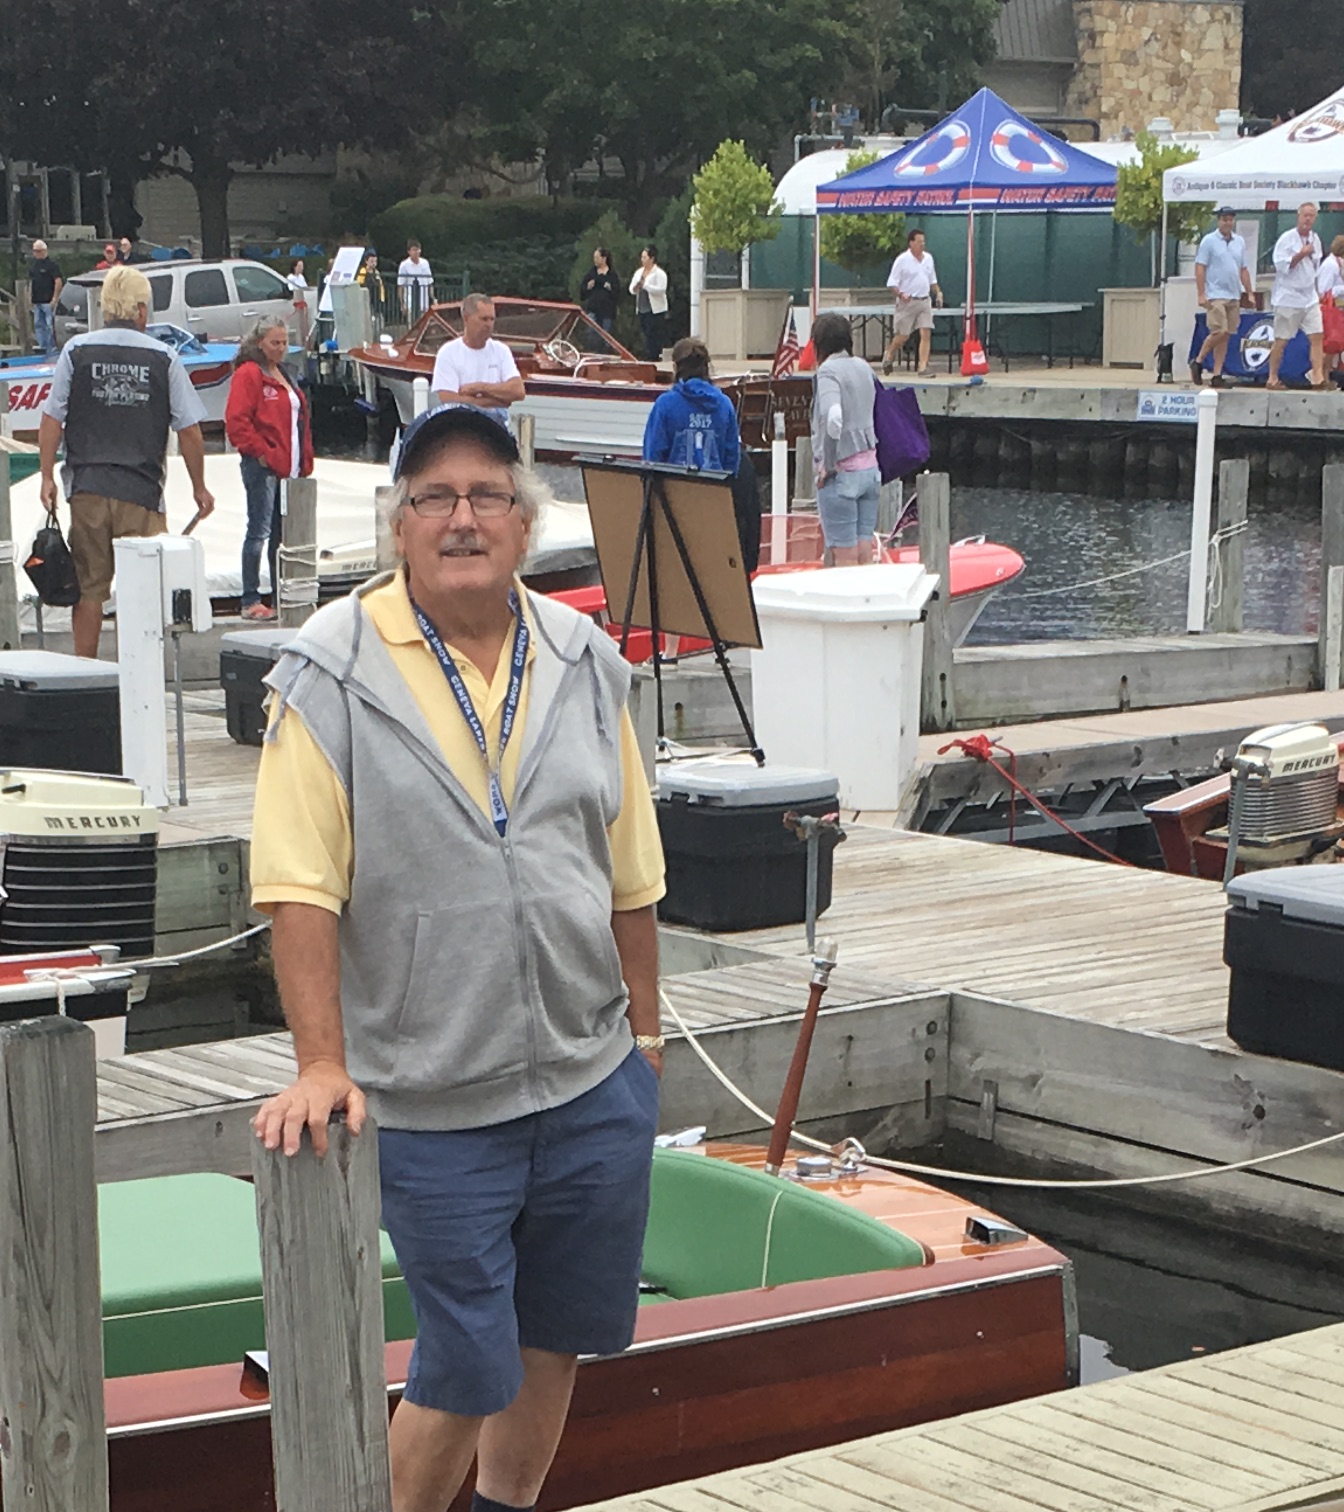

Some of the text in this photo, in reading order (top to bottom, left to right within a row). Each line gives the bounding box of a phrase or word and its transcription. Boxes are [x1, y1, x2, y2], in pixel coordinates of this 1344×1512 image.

[1216, 180, 1237, 189] Classic
[1239, 180, 1252, 189] Boat
[1254, 180, 1276, 191] Society
[1277, 180, 1311, 189] Blackhawk
[1313, 180, 1337, 191] Chapter
[91, 363, 150, 383] CHROME
[7, 383, 54, 411] SAF
[1162, 395, 1167, 404] 2
[1158, 406, 1197, 416] PARKING
[689, 419, 713, 429] 2017
[431, 635, 452, 666] SHOW
[450, 674, 471, 716] GENEVA
[508, 676, 520, 711] SHOW
[514, 628, 528, 667] GENEVA
[1282, 754, 1336, 772] MERCURY
[44, 815, 141, 829] MERCURY
